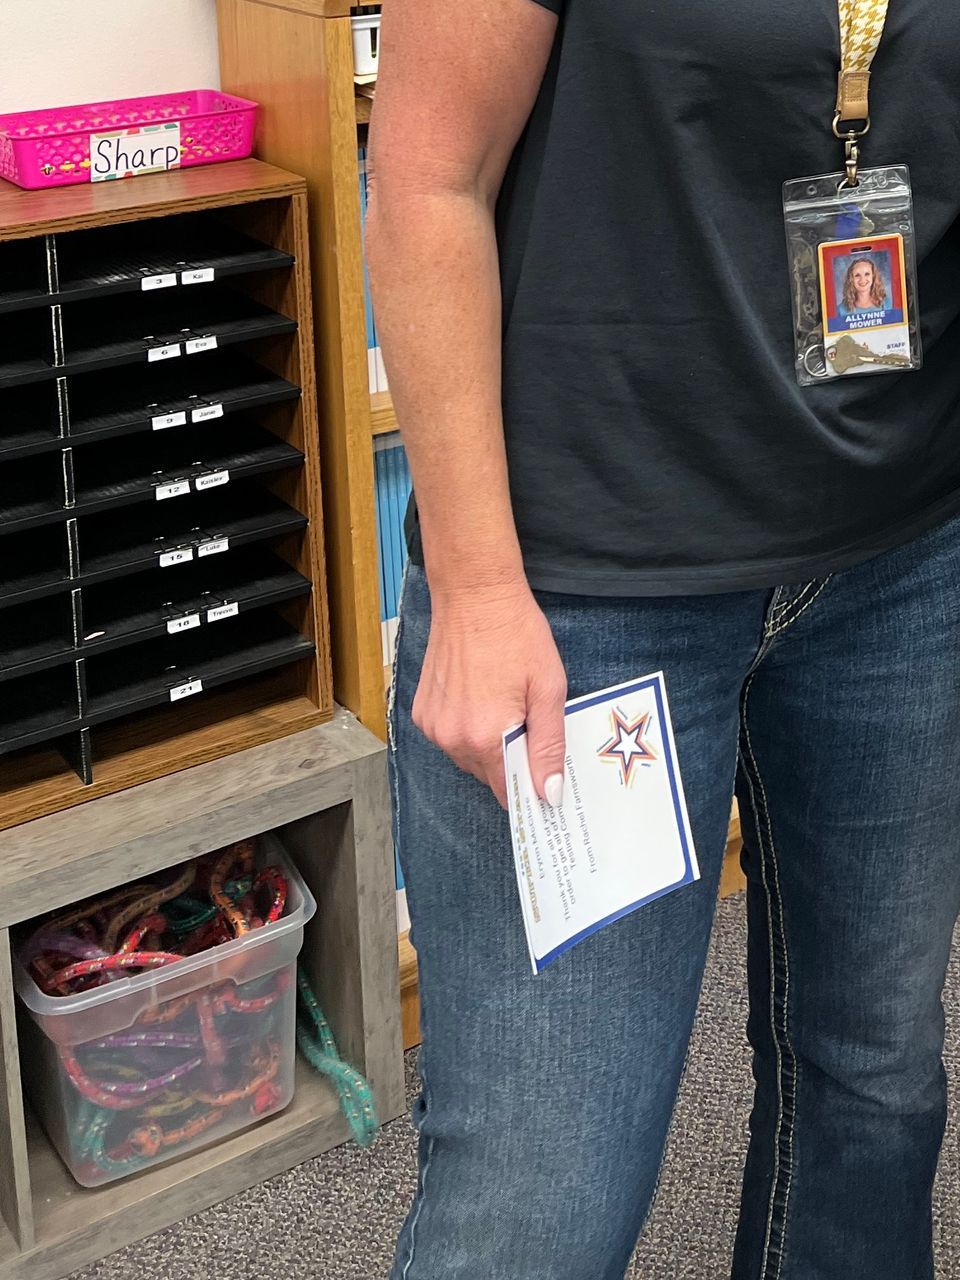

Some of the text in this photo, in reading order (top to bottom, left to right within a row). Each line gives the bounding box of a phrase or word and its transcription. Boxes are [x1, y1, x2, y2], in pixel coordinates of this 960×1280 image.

[94, 138, 179, 174] Sharp
[845, 311, 886, 323] ALLYNNE
[850, 318, 883, 329] MOWER
[887, 342, 905, 350] STAFF
[168, 486, 180, 494] 12
[179, 686, 192, 694] 21
[564, 754, 597, 874] From Rachel Farnsworth
[551, 820, 558, 831] of
[547, 838, 555, 851] all
[554, 834, 562, 845] all
[558, 847, 567, 863] get
[564, 832, 576, 870] Testing
[563, 866, 569, 876] to
[555, 869, 565, 888] you
[566, 879, 576, 905] order
[560, 890, 571, 921] Thank
